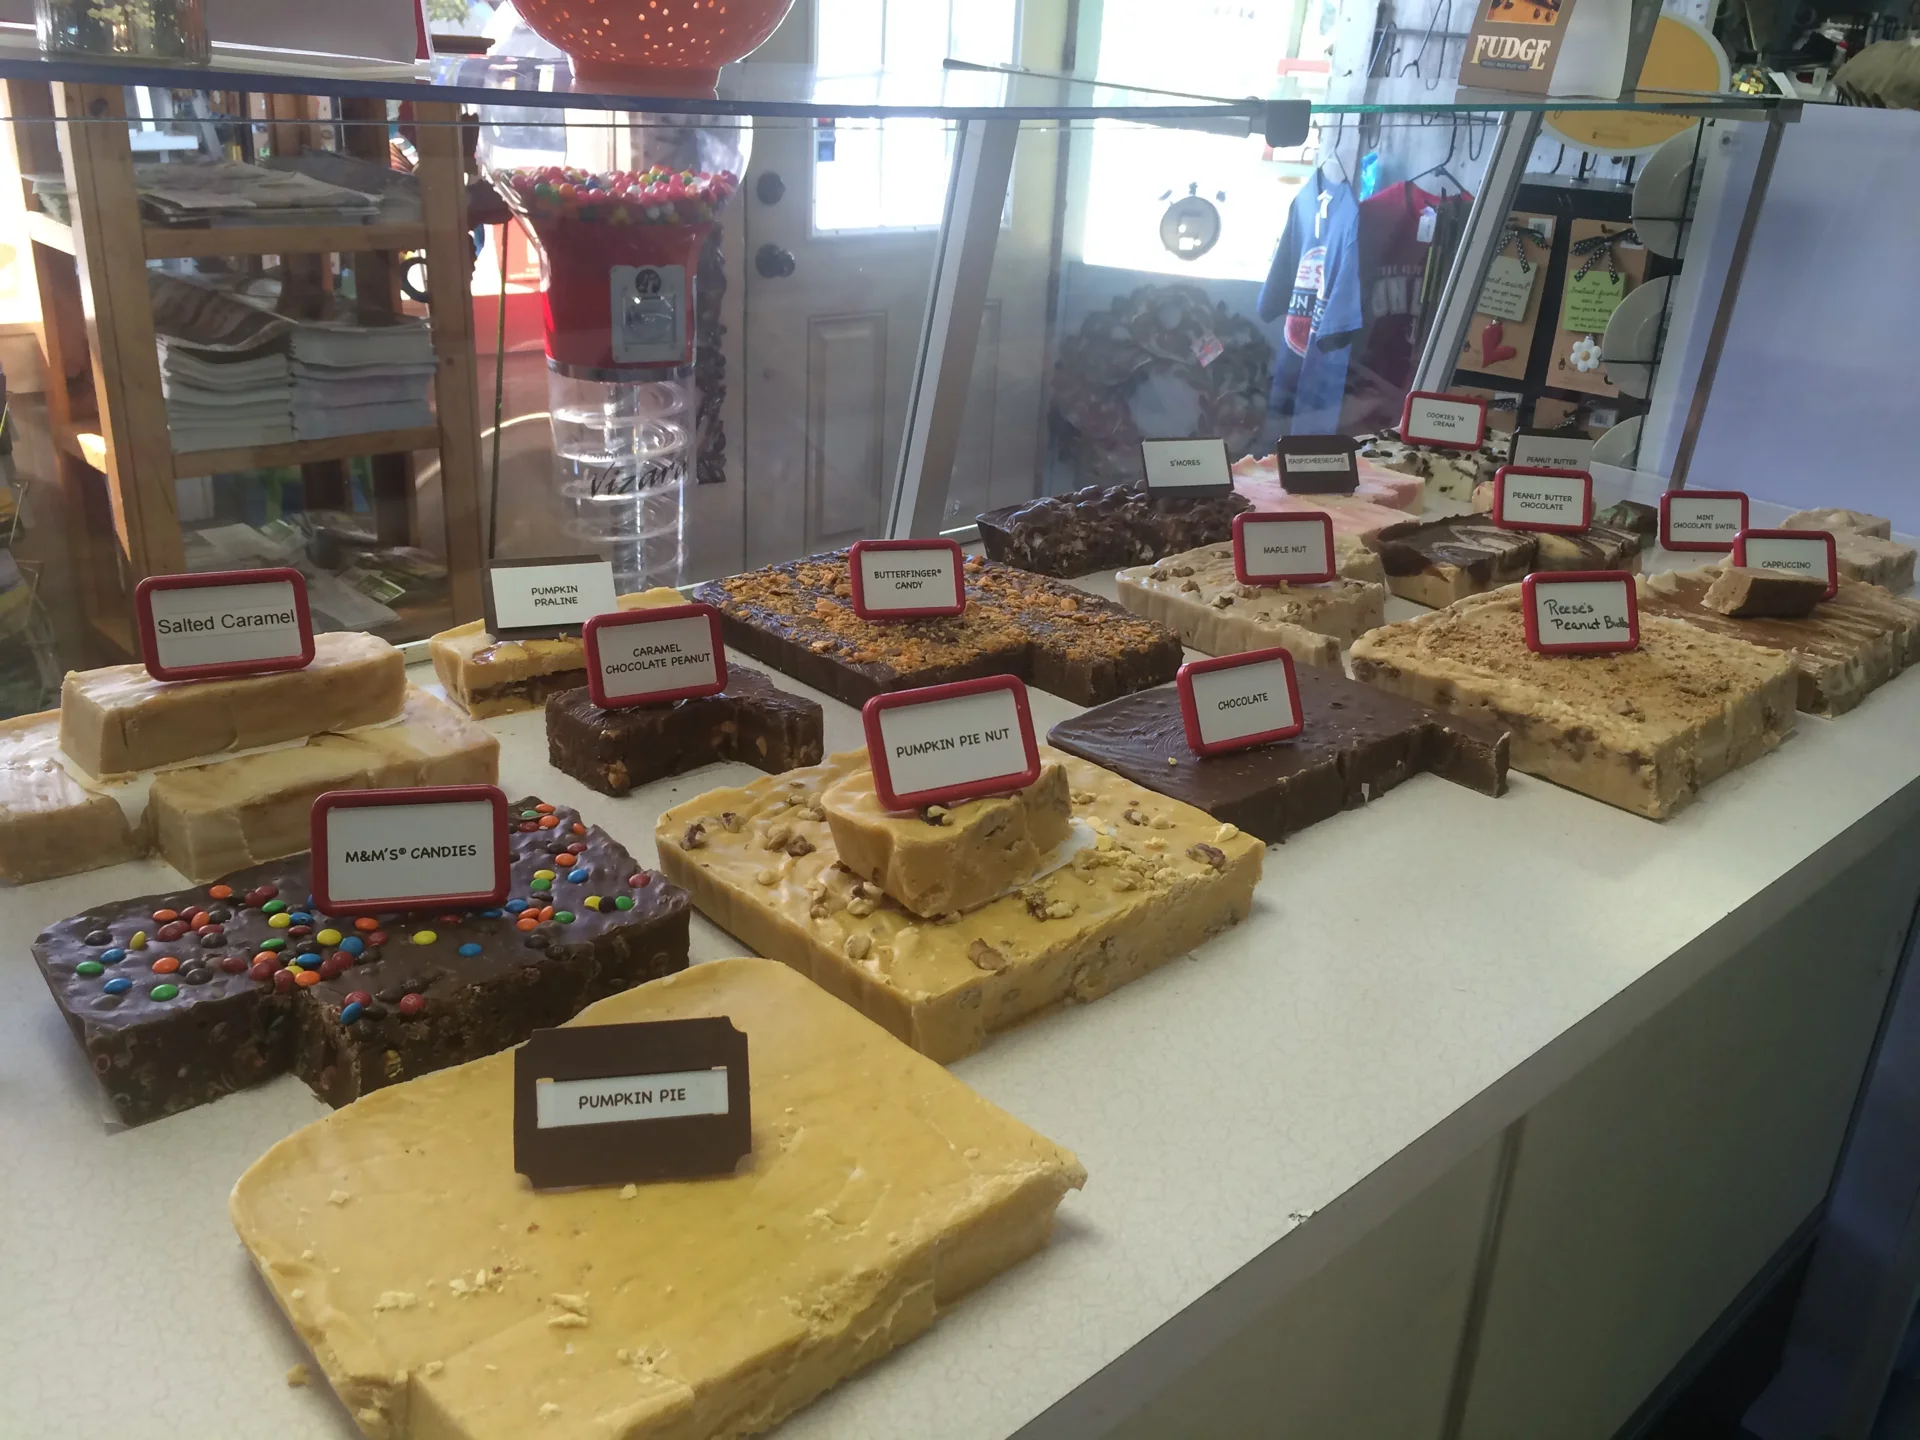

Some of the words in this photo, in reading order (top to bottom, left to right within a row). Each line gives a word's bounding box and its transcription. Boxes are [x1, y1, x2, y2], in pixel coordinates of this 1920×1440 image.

[1470, 34, 1551, 71] FUDGE
[1426, 411, 1455, 421] COOKIES
[1432, 420, 1456, 429] CREAM
[1169, 459, 1201, 467] S'MORES
[1526, 456, 1552, 464] PEANUT
[1553, 457, 1578, 466] BUTTER
[1512, 491, 1542, 500] PEANUT
[1544, 493, 1572, 502] BUTTER
[1519, 501, 1564, 511] CHOCOLATE
[1673, 522, 1713, 530] CHOCOLATE
[1263, 546, 1289, 555] MAPLE
[1291, 545, 1308, 554] NUT
[1761, 560, 1812, 570] CAPPUCCINO
[530, 584, 579, 596] PUMPKIN
[895, 581, 924, 590] CANDY
[533, 596, 579, 608] PRALINE
[1543, 599, 1595, 616] Reese's
[157, 616, 216, 635] Salted
[220, 609, 296, 630] Caramel
[1550, 617, 1602, 631] Peanut
[632, 643, 683, 658] CARAMEL
[605, 657, 668, 676] CHOCOLATE
[670, 652, 712, 667] PEANUT
[1217, 692, 1269, 711] CHOCOLATE
[896, 737, 956, 759] PUMPKIN
[959, 733, 981, 747] PIE
[984, 728, 1010, 743] NUT
[410, 845, 478, 860] CANDIES
[578, 1091, 653, 1110] PUMPKIN
[659, 1088, 687, 1103] PIE
